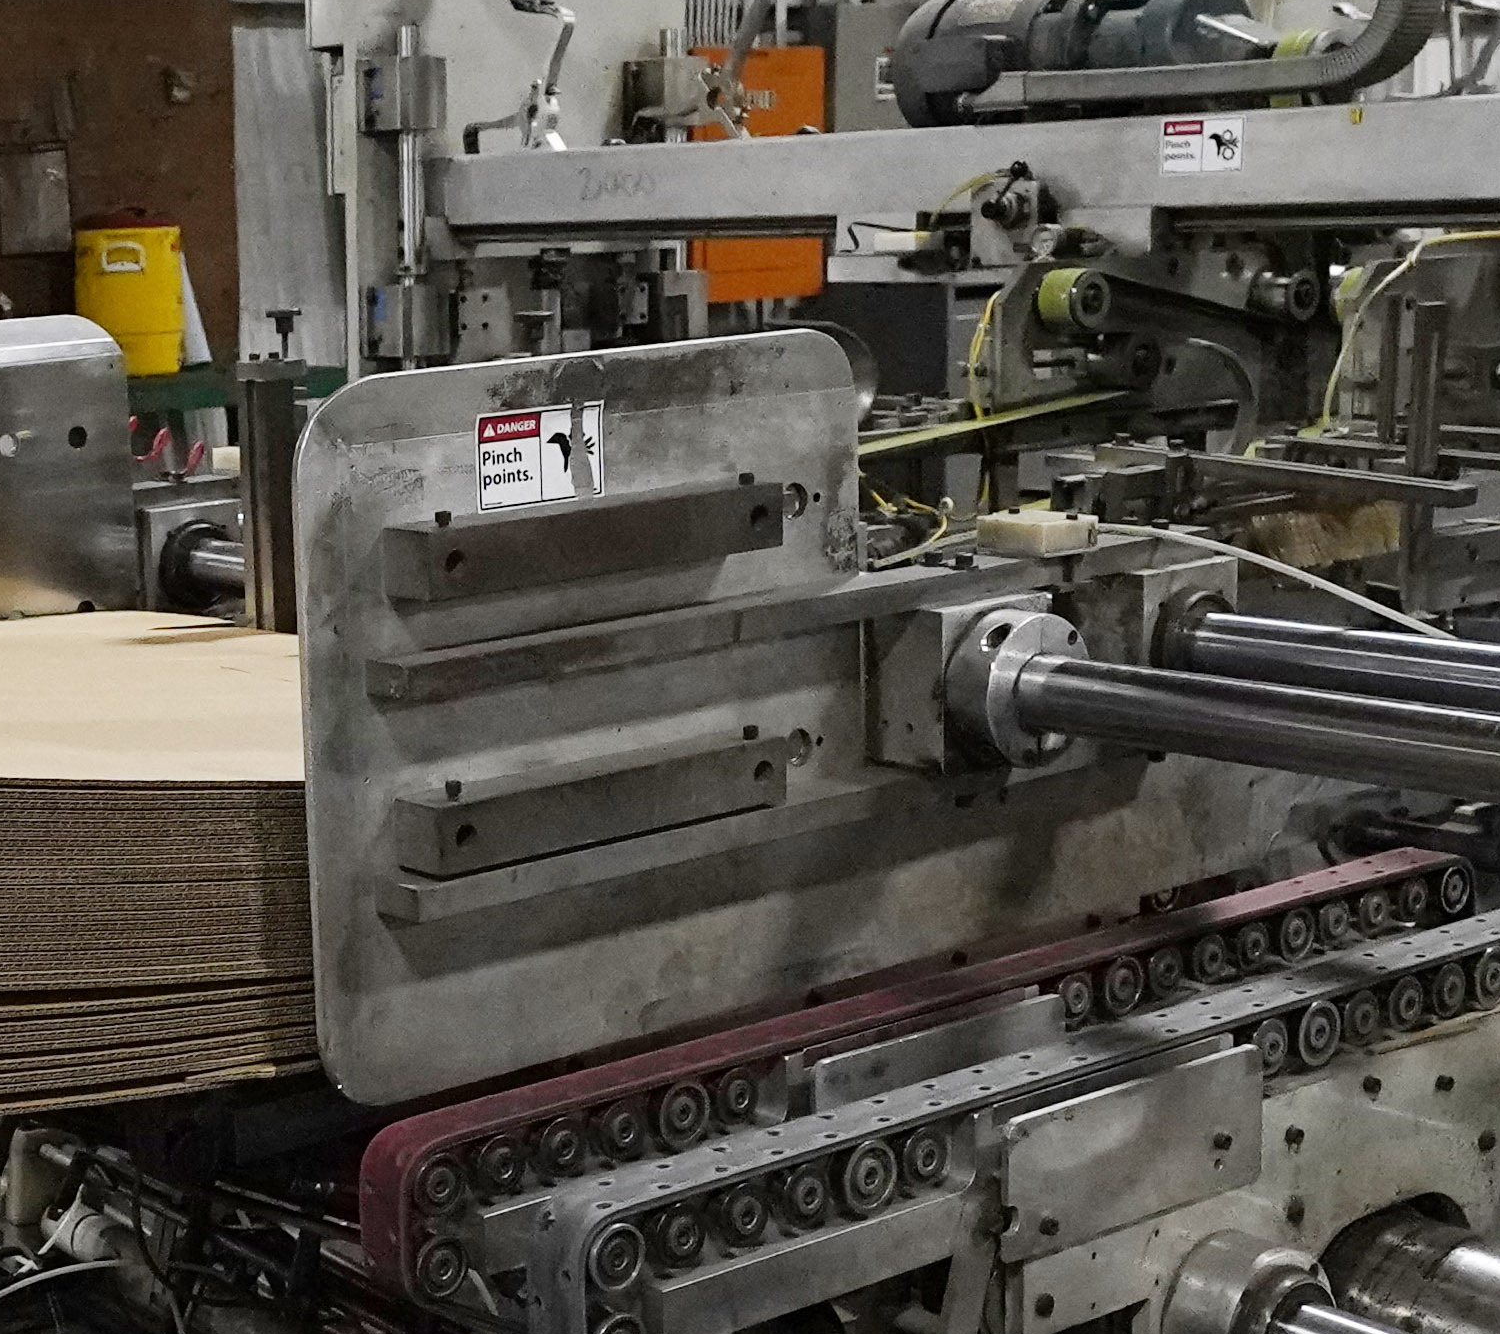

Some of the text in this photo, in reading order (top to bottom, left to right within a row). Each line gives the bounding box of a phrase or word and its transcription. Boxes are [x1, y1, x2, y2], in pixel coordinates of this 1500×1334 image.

[496, 419, 537, 434] DANGER
[482, 447, 523, 466] Pinch
[483, 468, 534, 491] points.
